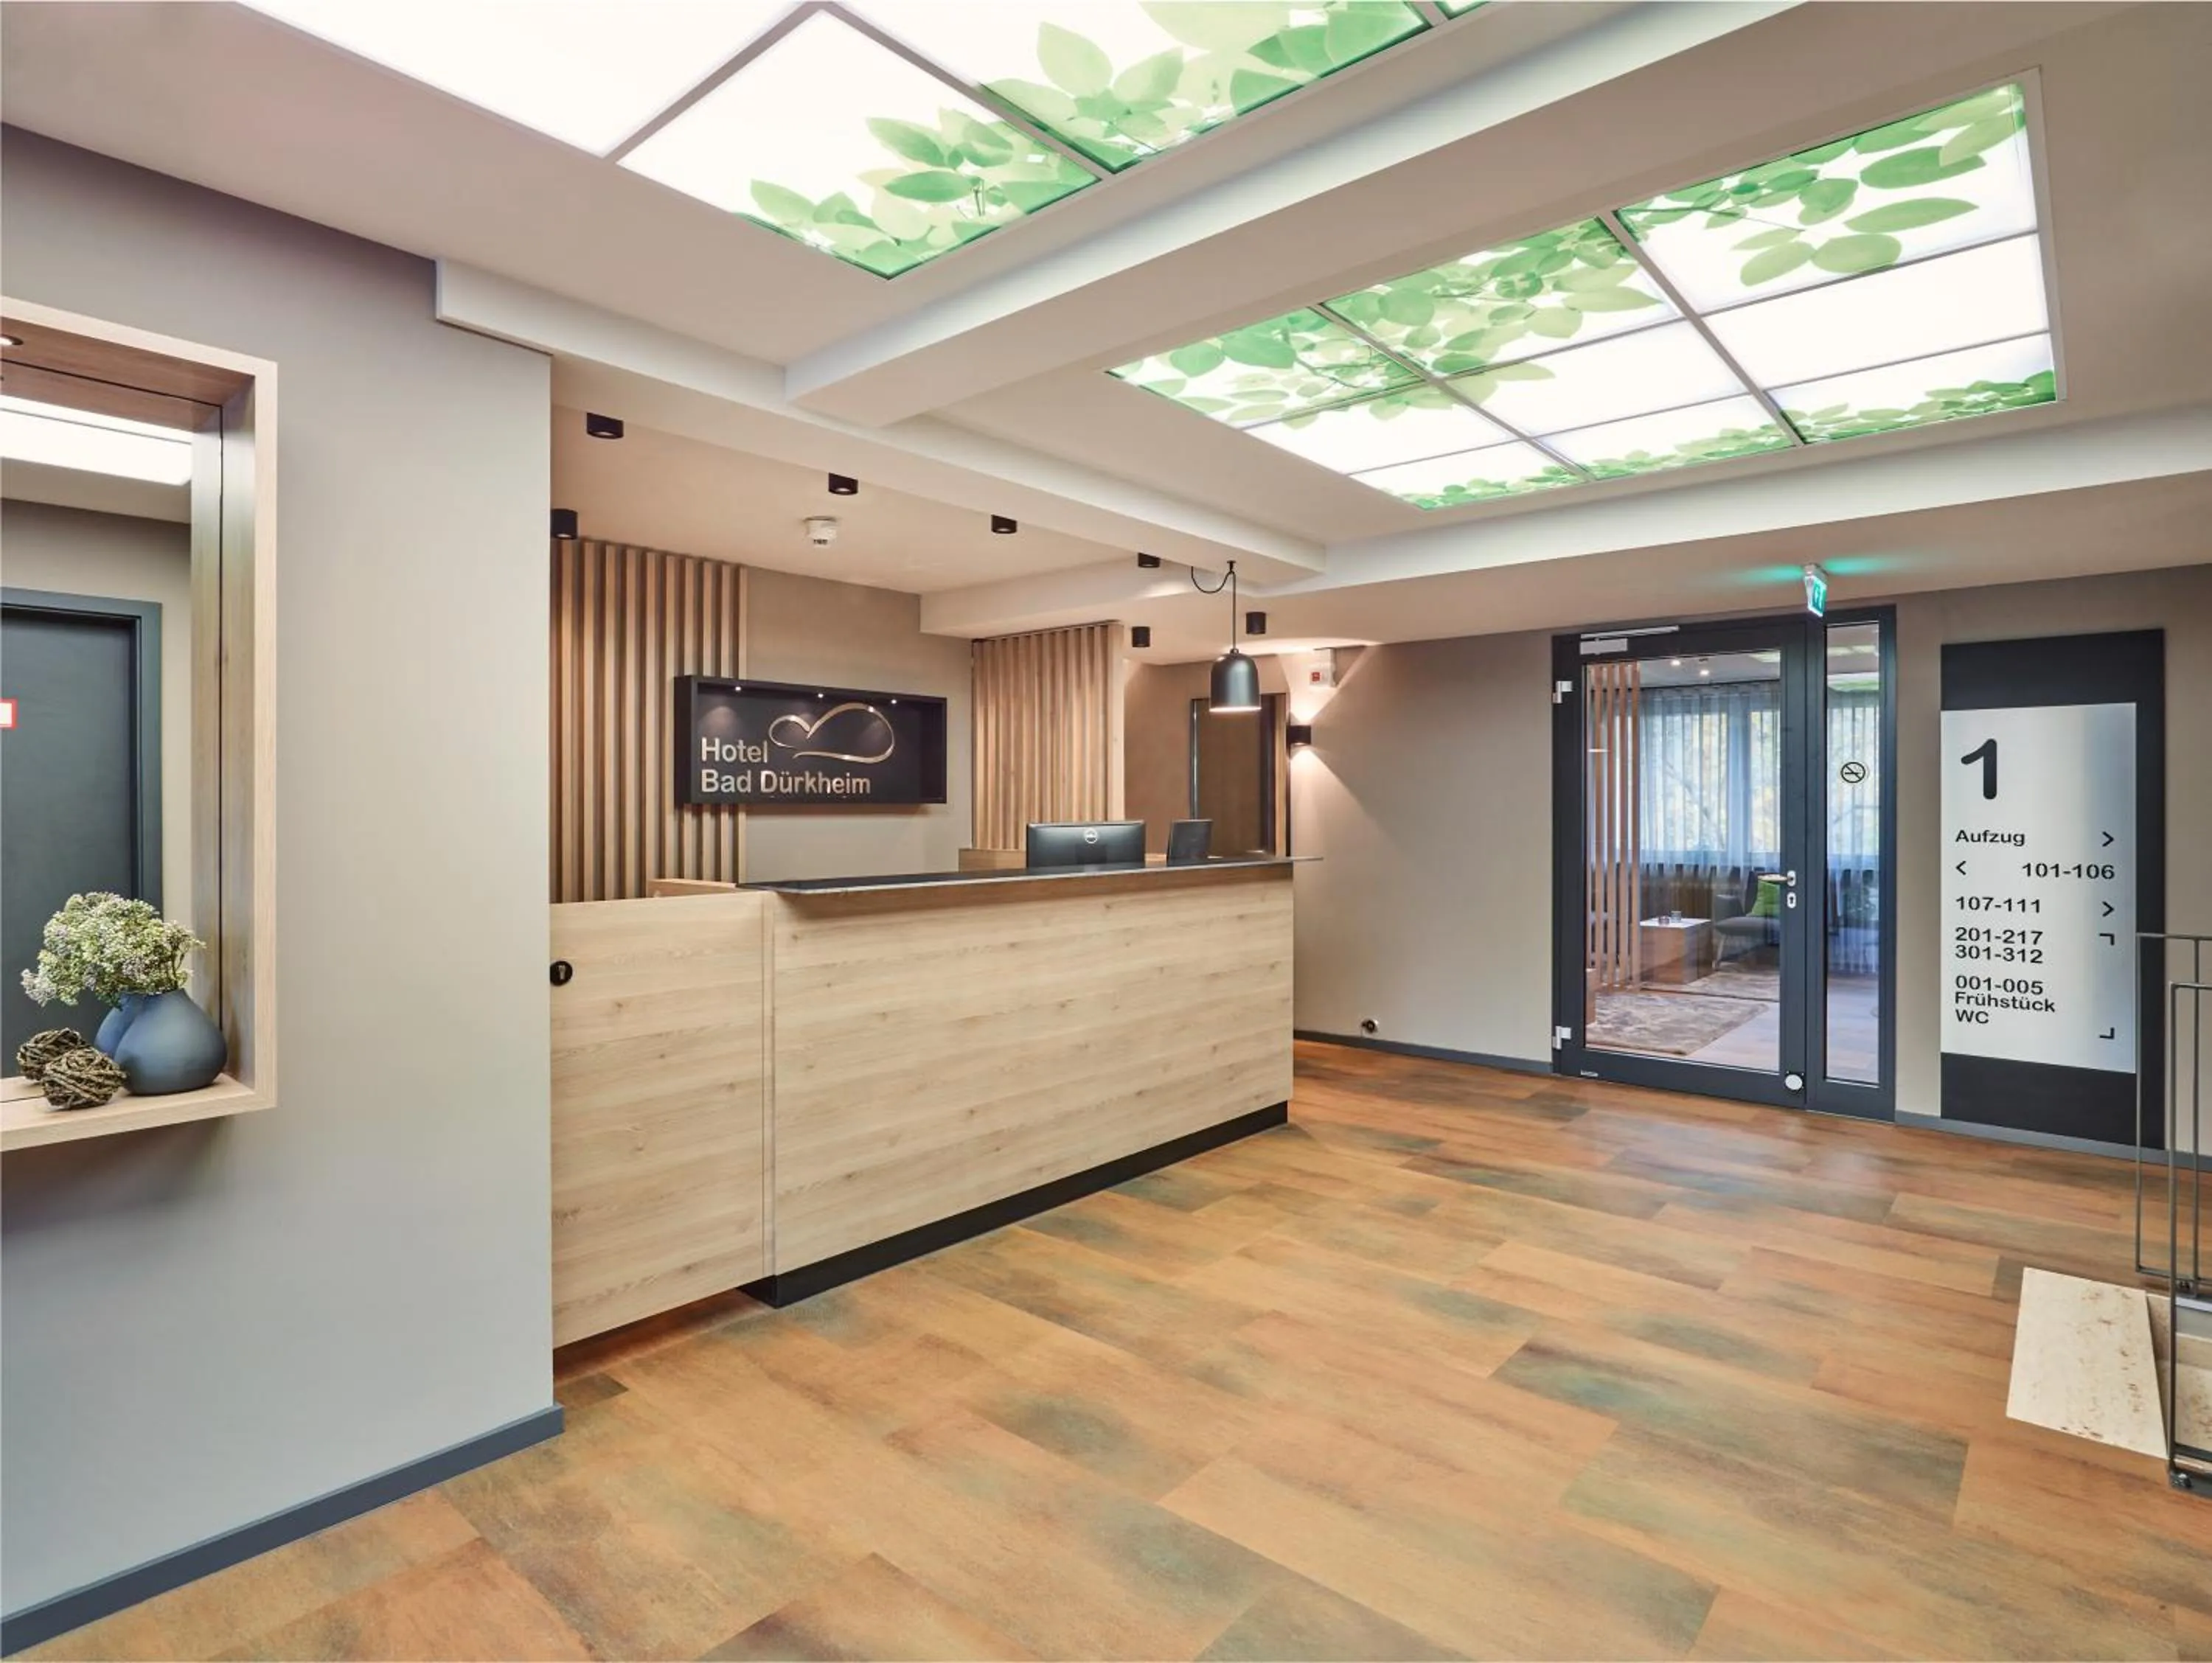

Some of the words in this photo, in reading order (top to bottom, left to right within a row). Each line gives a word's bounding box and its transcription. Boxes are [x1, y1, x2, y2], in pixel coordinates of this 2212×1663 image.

[701, 736, 768, 763] Hotel
[1961, 738, 1997, 800] 1
[701, 769, 752, 793] Bad
[760, 770, 871, 794] Dürkheim
[1955, 829, 2025, 847] Aufzug
[2022, 862, 2115, 880] 101-106
[1955, 896, 2040, 913] 107-111
[1955, 927, 2043, 945] 201-217
[1955, 945, 2043, 963] 301-312
[1955, 975, 2043, 995] 001-005
[1955, 991, 2056, 1012] Frühstück
[1955, 1009, 1989, 1024] WC
